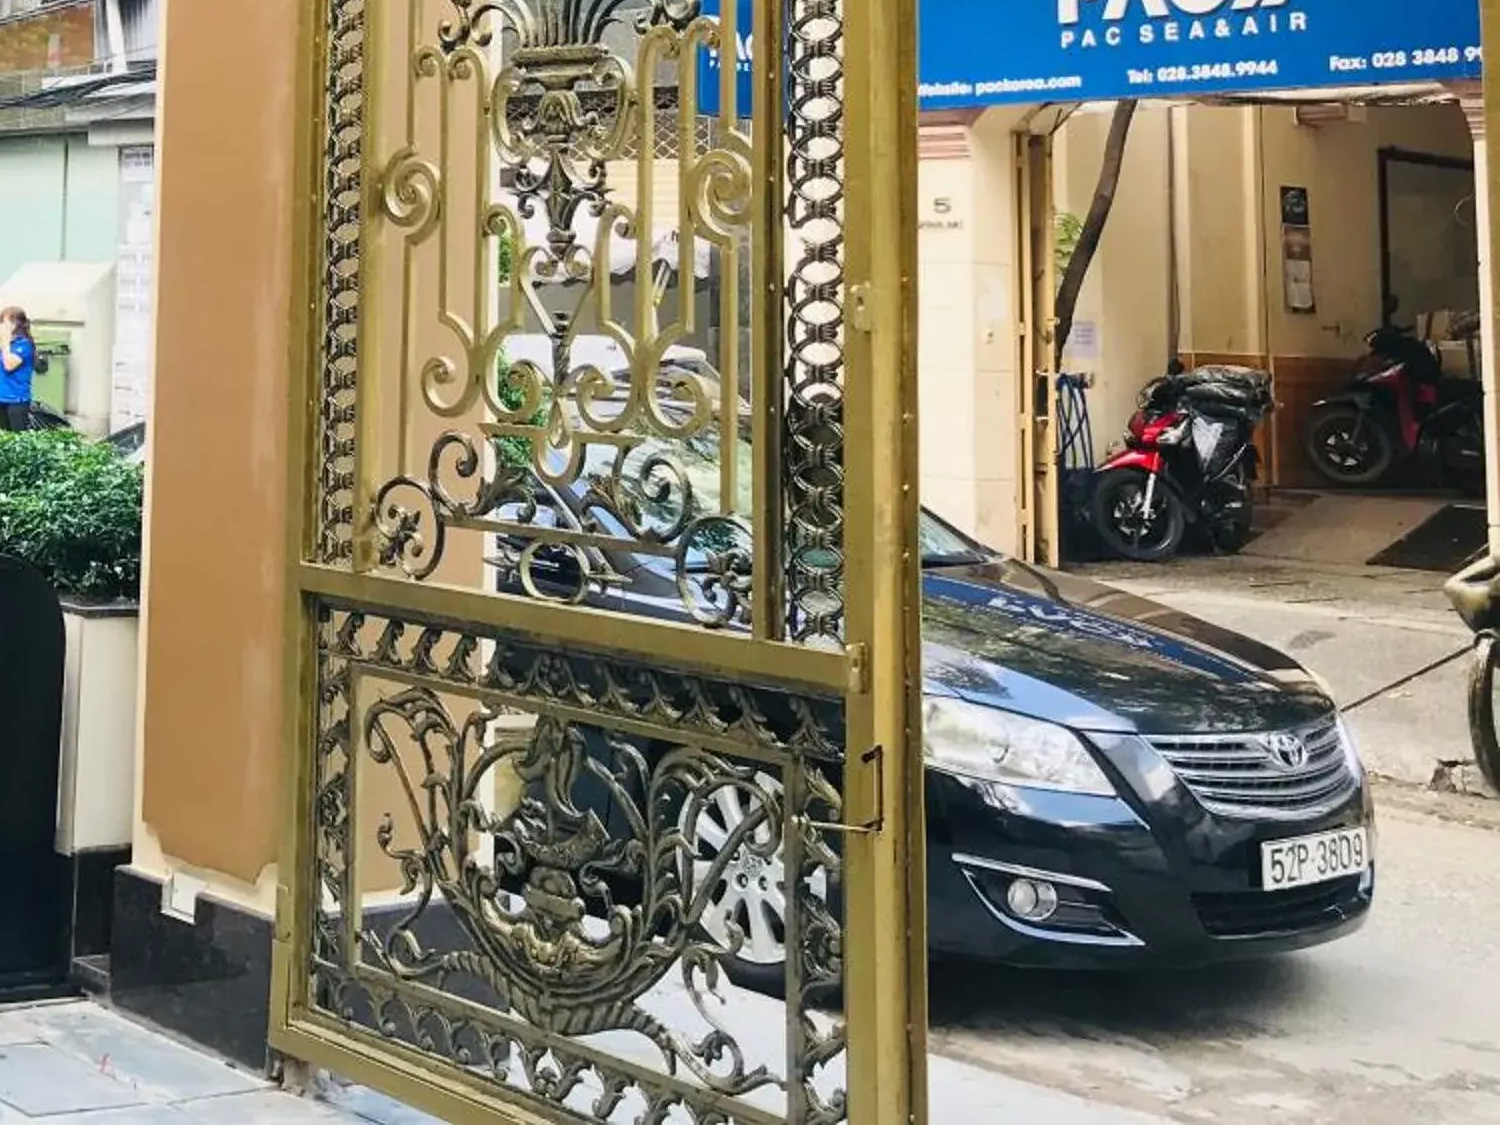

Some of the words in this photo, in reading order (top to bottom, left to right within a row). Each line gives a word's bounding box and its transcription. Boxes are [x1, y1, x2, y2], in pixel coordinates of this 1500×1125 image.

[1060, 26, 1122, 50] PAC
[1329, 55, 1367, 71] Fax:
[1371, 50, 1407, 69] 028
[1411, 46, 1460, 66] 3848
